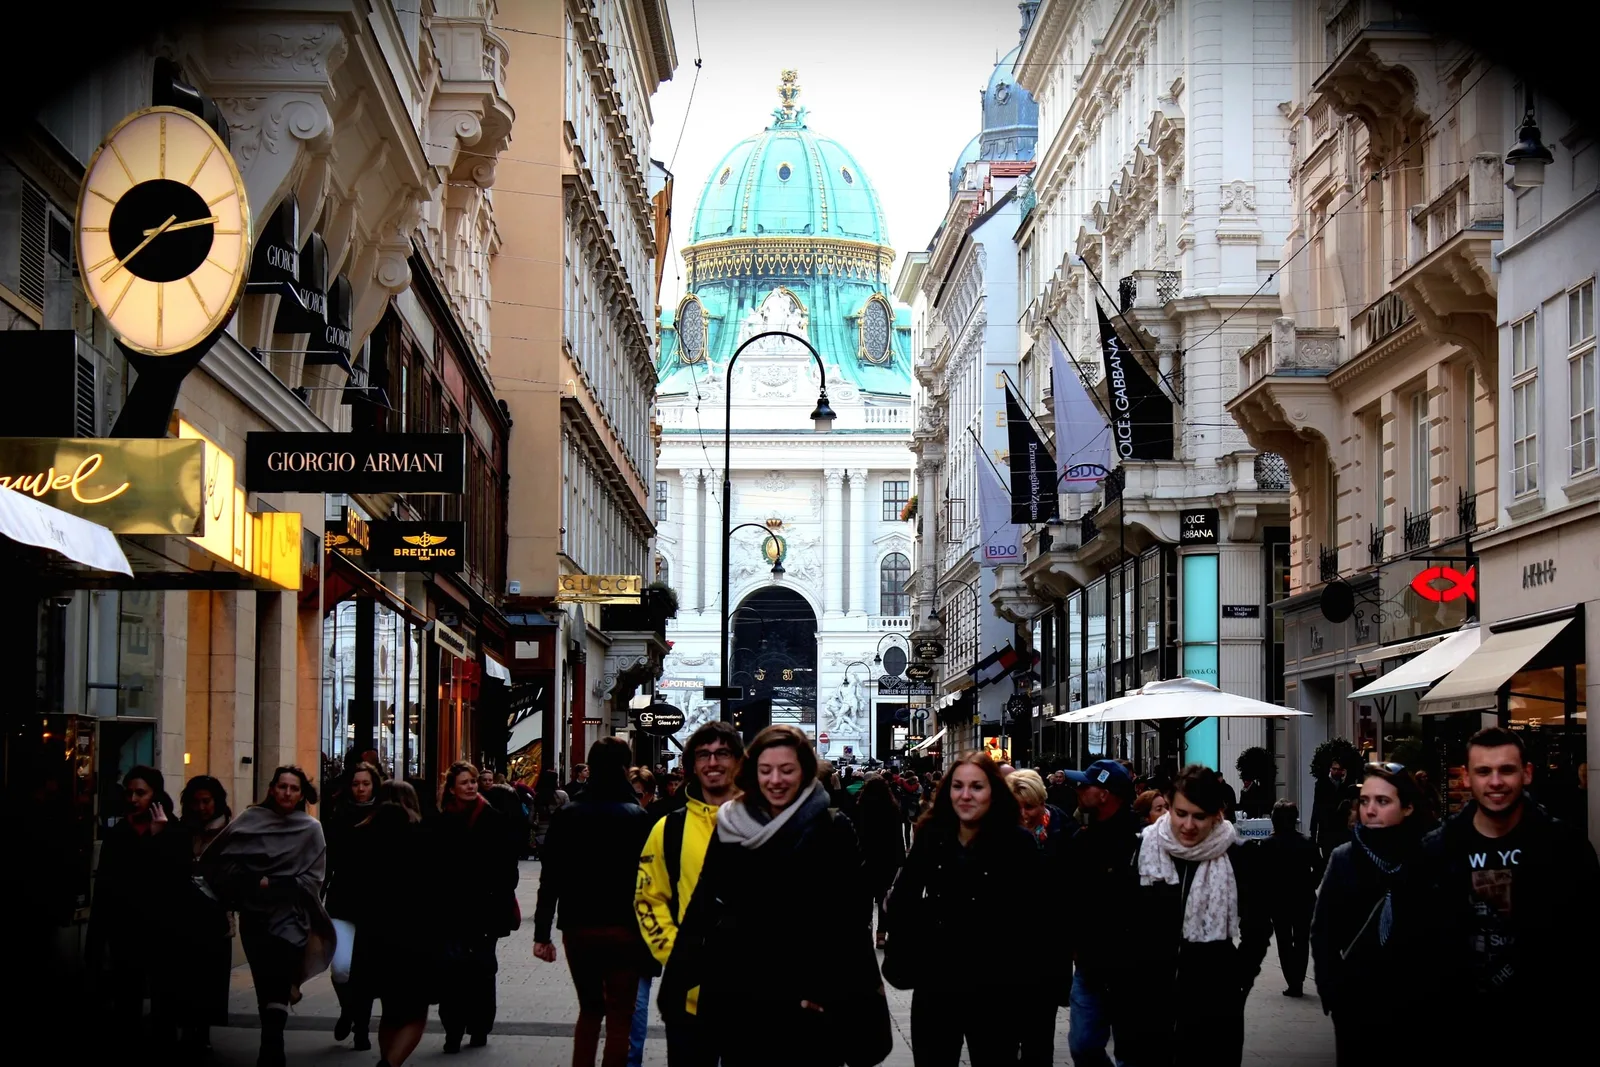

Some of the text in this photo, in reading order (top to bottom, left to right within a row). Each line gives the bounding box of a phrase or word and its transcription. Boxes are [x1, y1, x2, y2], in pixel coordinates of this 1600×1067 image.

[267, 244, 295, 273] GIORG
[300, 288, 325, 315] GIORG
[1107, 336, 1129, 412] GABBANA
[1117, 420, 1133, 460] OLCE
[267, 451, 444, 473] GIORGIO ARMANI
[1069, 464, 1105, 478] BDO
[393, 548, 457, 557] BREITLING
[989, 544, 1018, 556] BDO
[563, 578, 640, 592] GUCCI
[640, 712, 653, 723] GS
